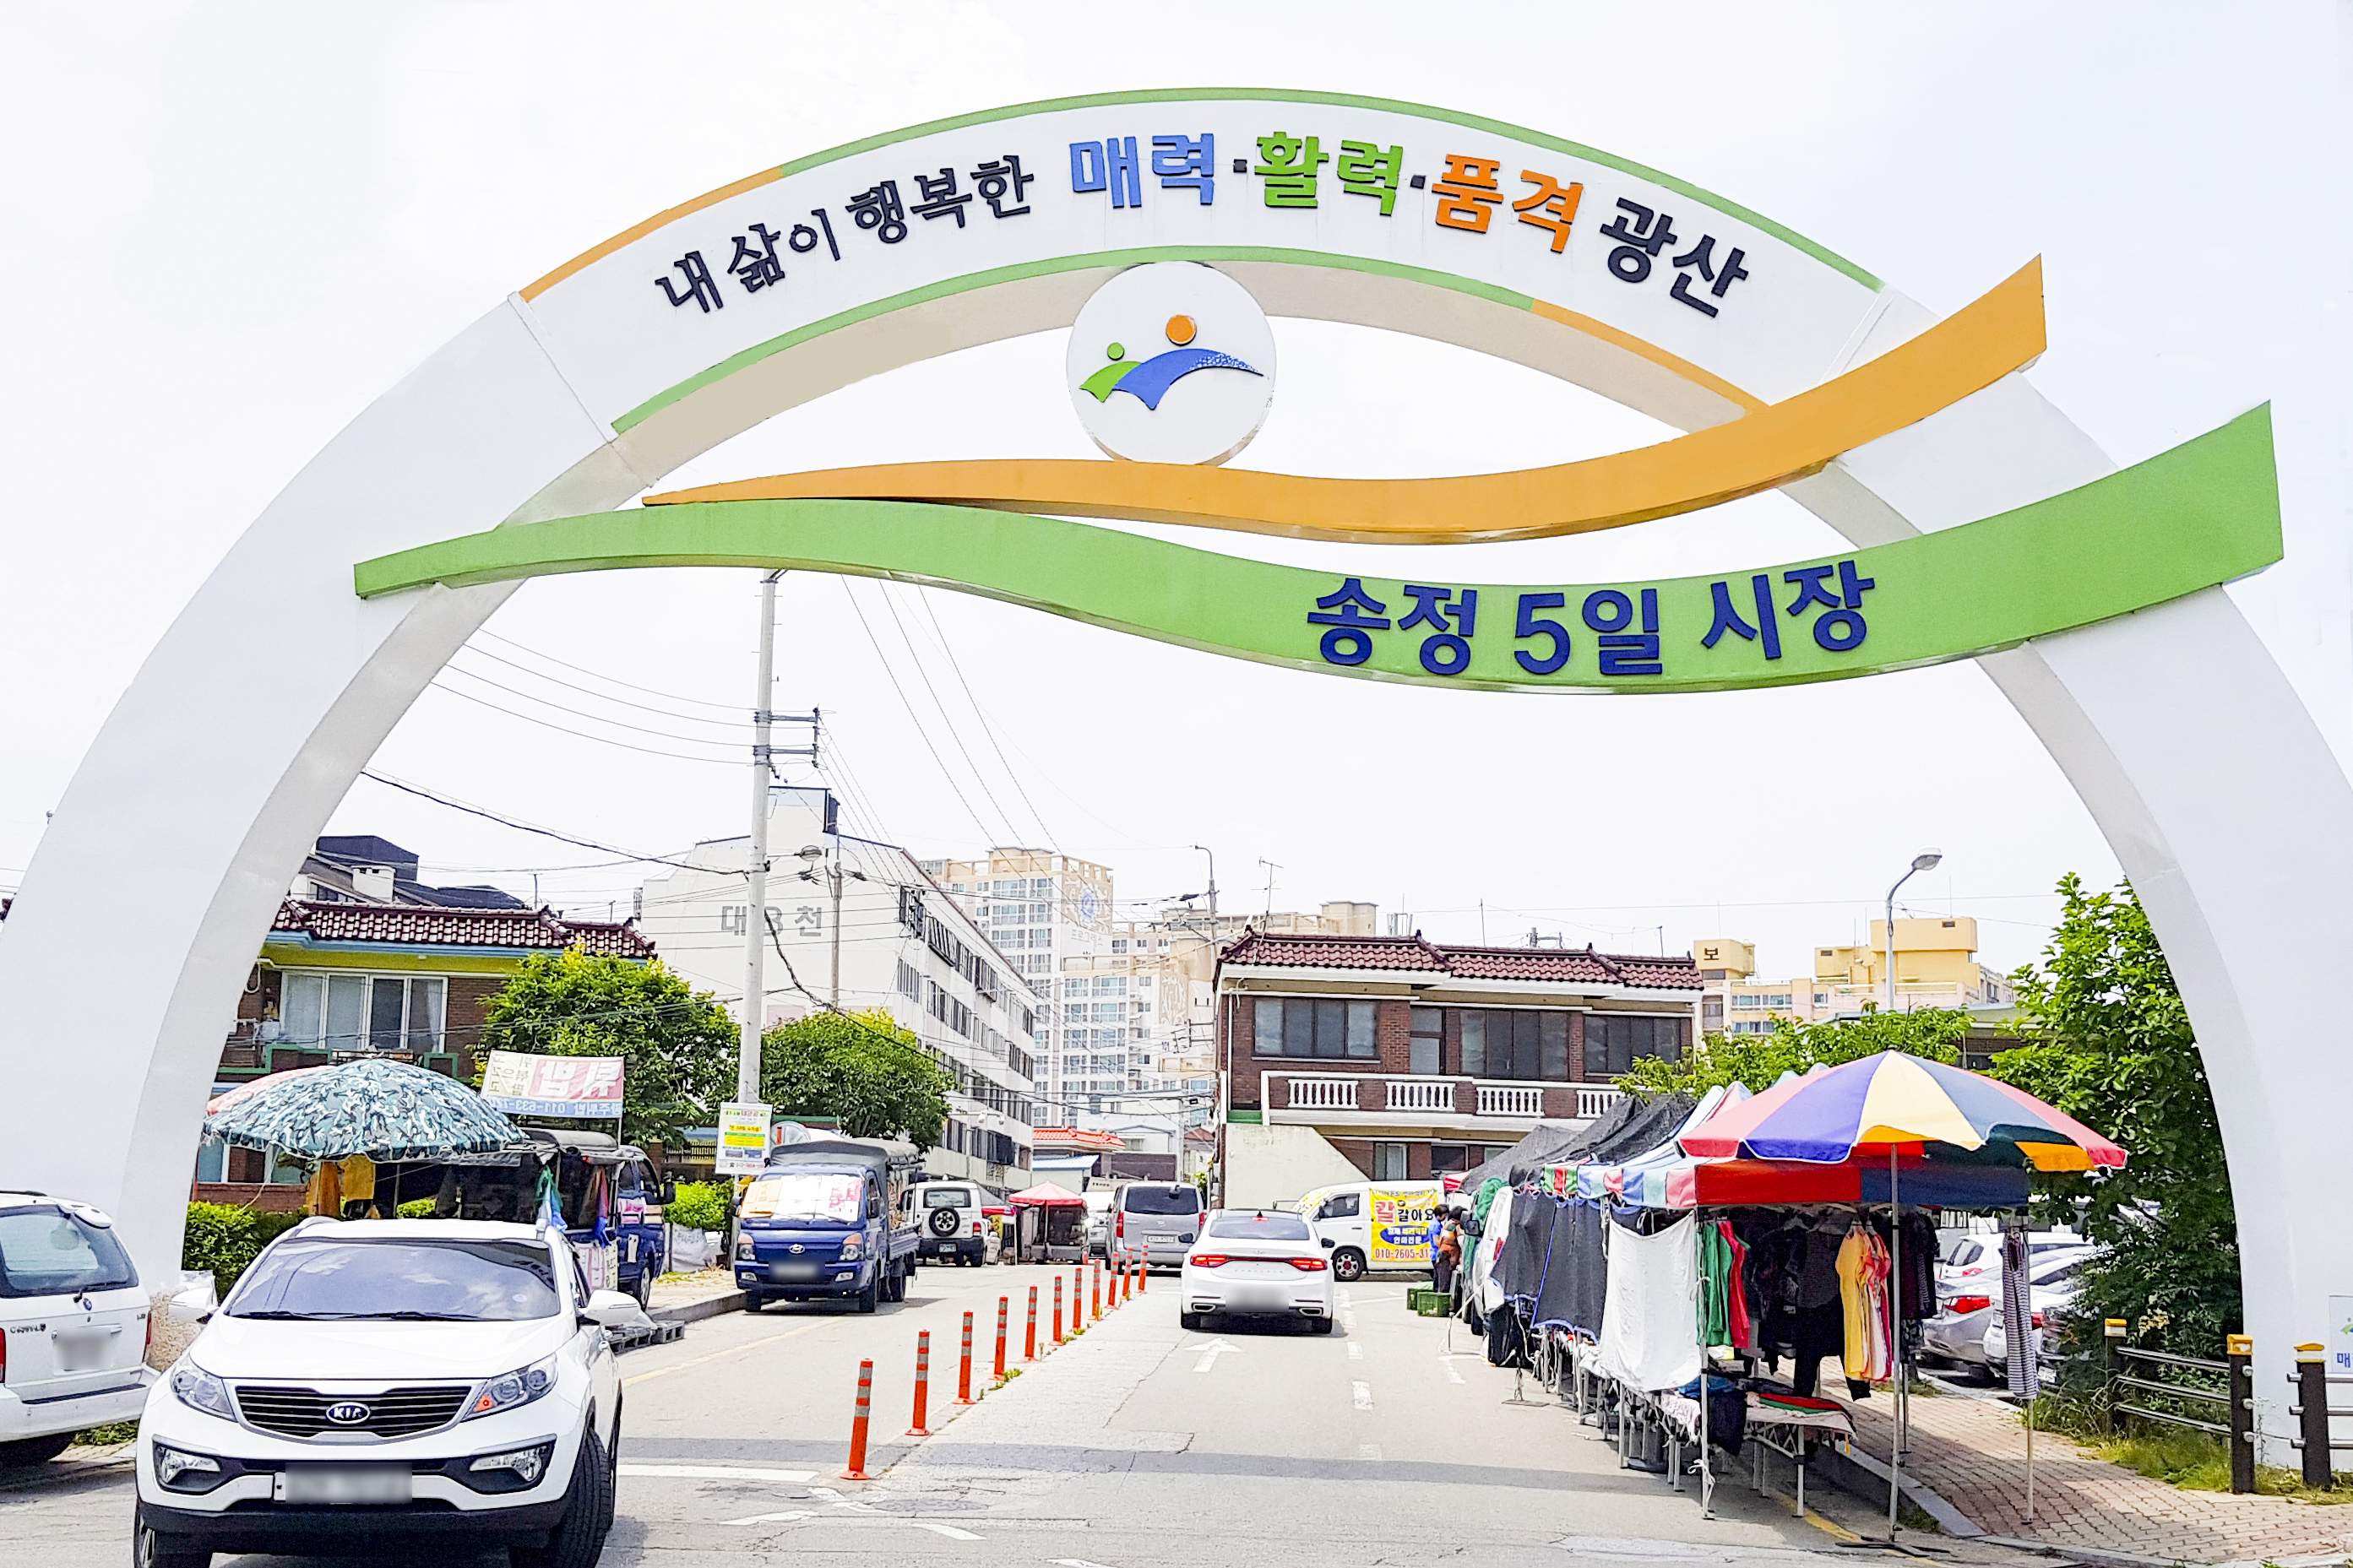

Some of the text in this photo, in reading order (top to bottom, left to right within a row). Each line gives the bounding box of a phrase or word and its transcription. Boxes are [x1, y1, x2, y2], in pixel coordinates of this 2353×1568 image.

[654, 250, 724, 314] 내
[726, 208, 841, 294] 삶이
[844, 155, 1035, 245] 행복한
[1599, 196, 1749, 319] 광산
[1307, 559, 1876, 677] 송정 5일 시장
[1703, 947, 1720, 961] 보
[1374, 1201, 1395, 1223] 칼
[1398, 1208, 1435, 1223] 갈아요
[2336, 1353, 2353, 1368] 매
[334, 1407, 363, 1419] KIA
